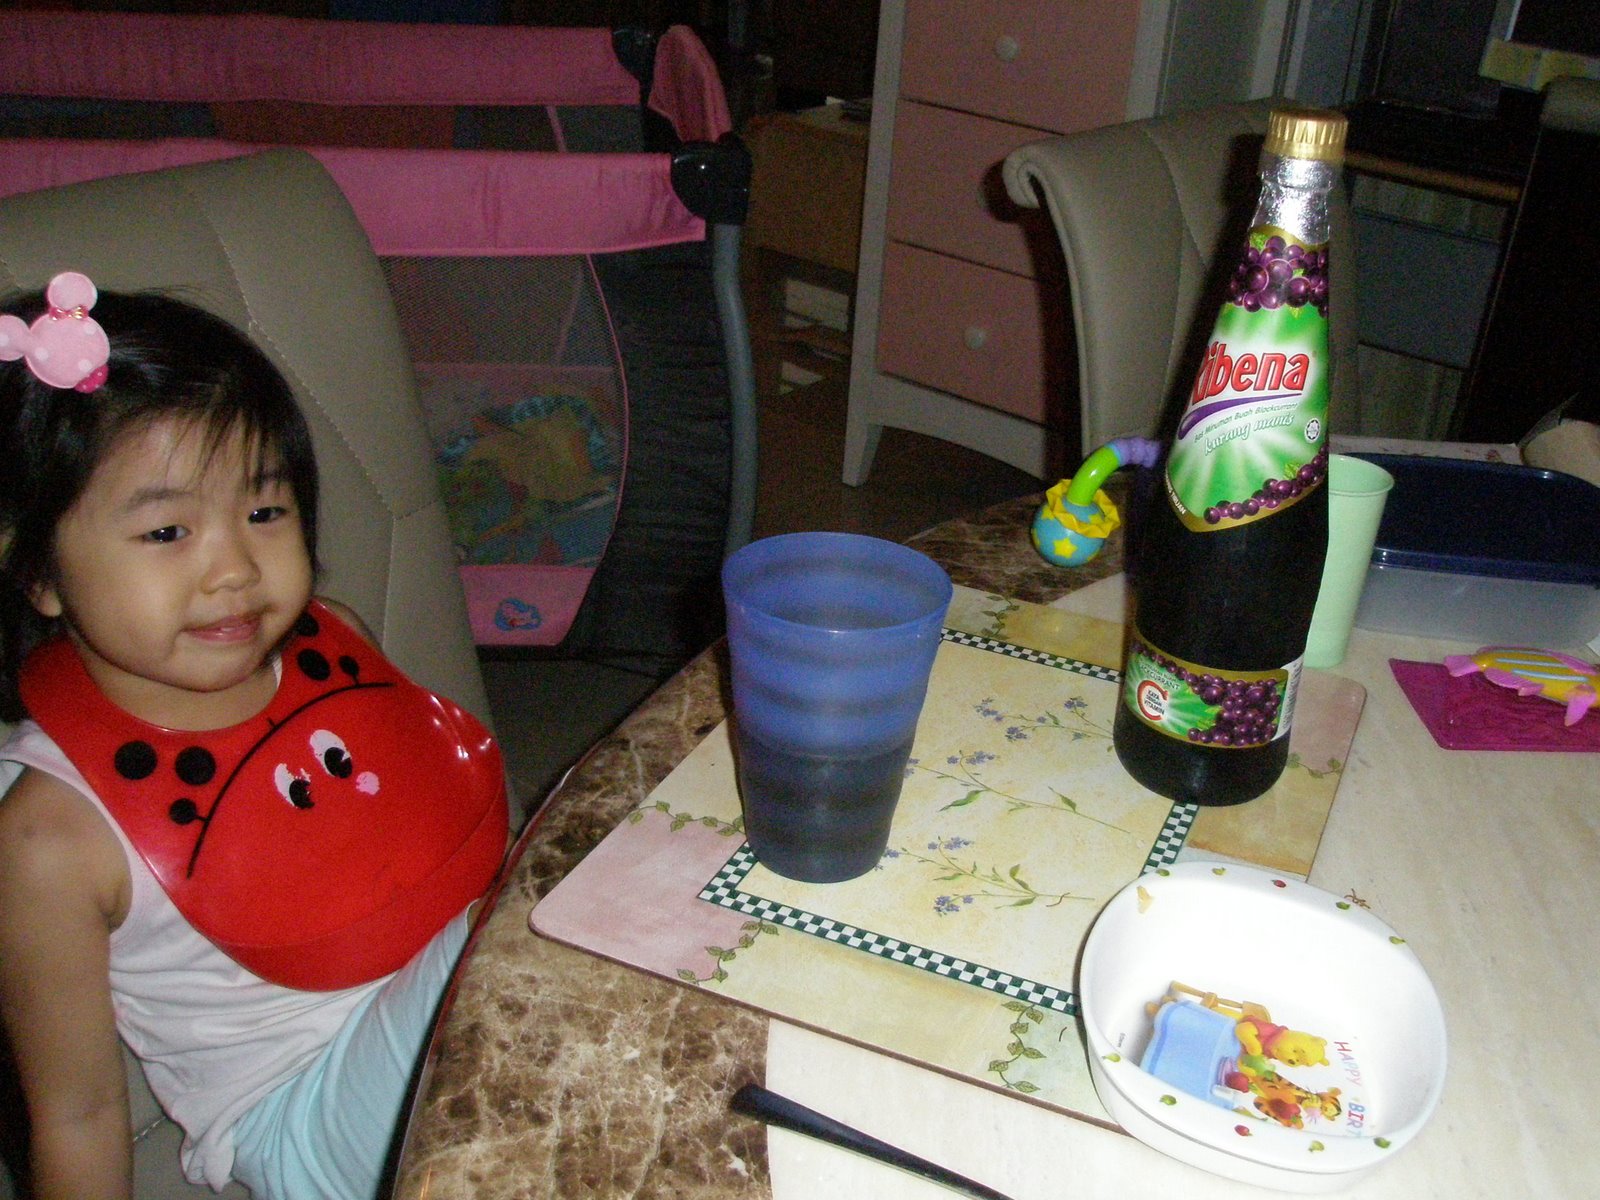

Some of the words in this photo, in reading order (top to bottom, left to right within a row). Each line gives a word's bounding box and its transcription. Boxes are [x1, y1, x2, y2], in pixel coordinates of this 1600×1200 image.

[1205, 422, 1251, 456] kurang
[1253, 413, 1295, 432] manis
[1333, 1041, 1361, 1087] HAPPY
